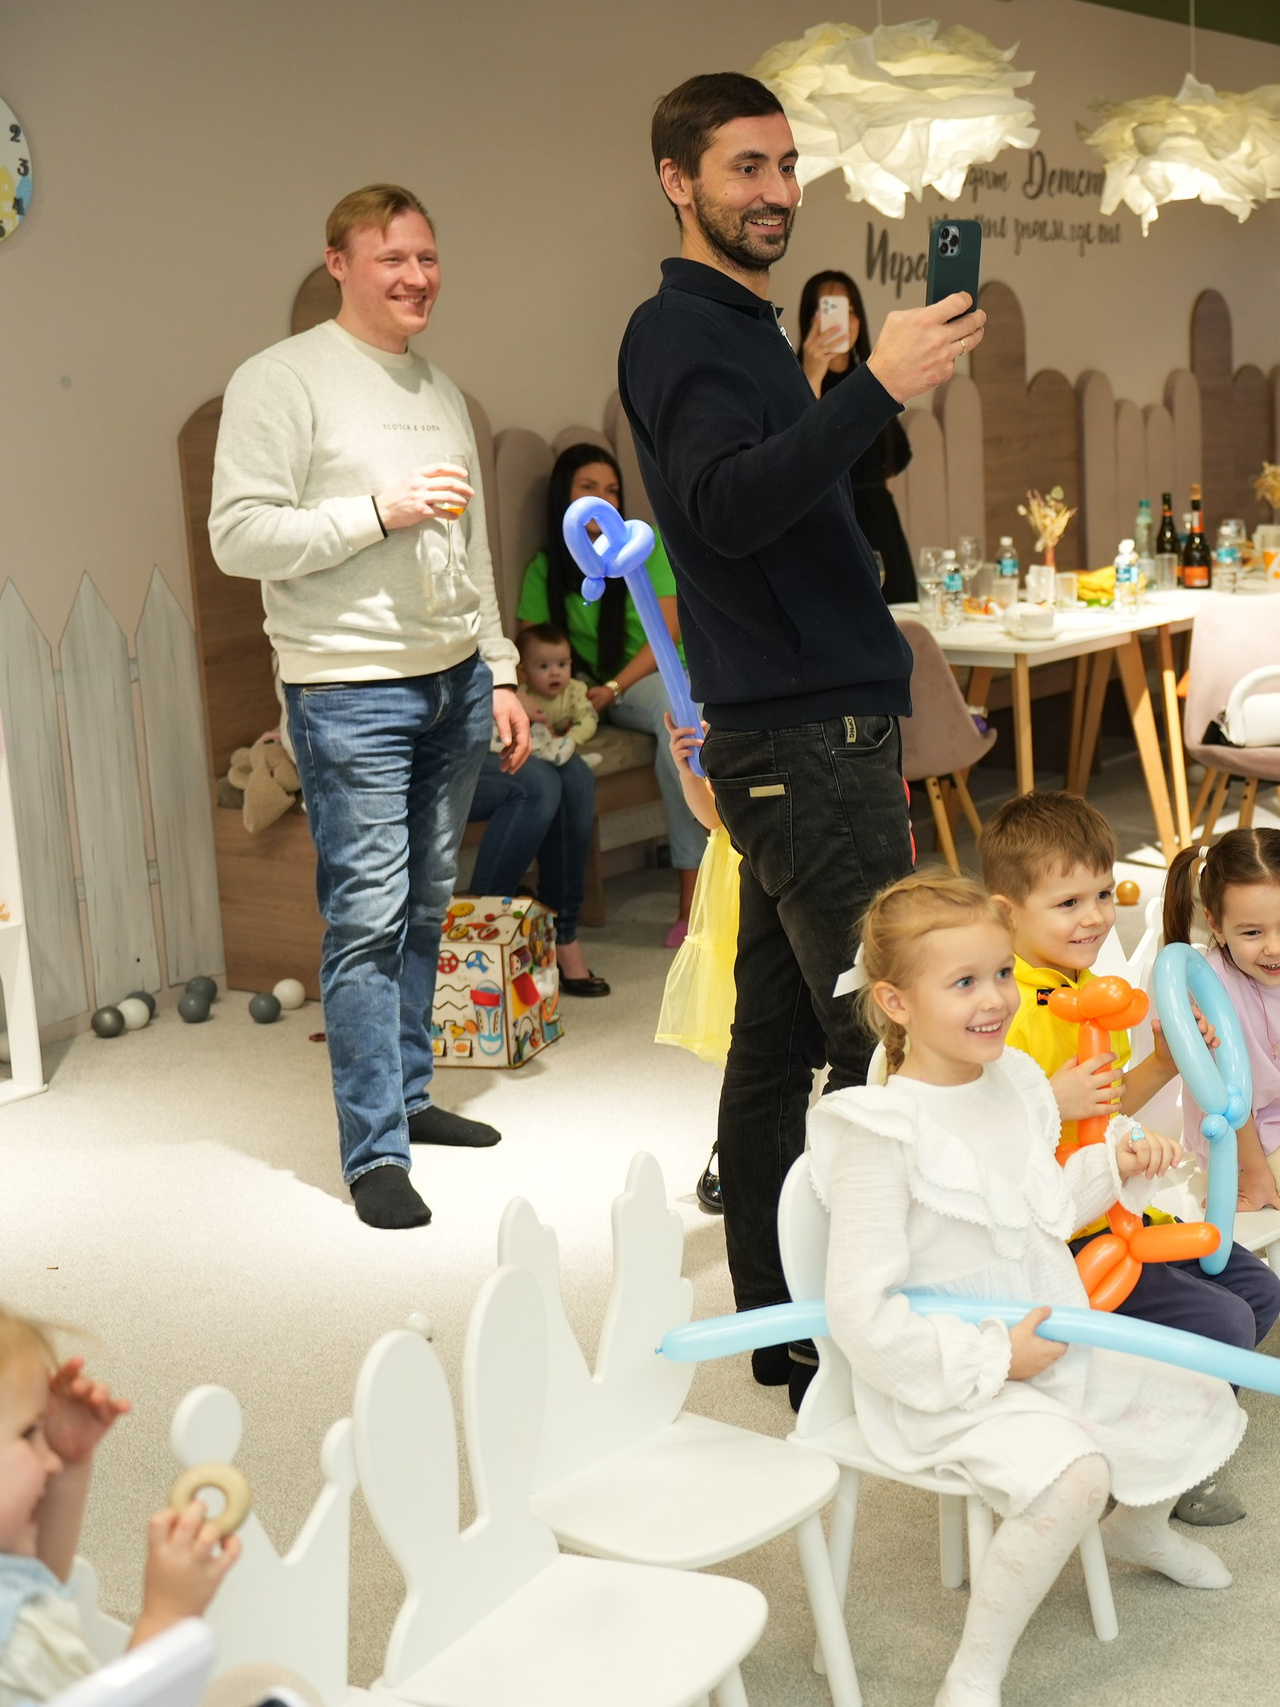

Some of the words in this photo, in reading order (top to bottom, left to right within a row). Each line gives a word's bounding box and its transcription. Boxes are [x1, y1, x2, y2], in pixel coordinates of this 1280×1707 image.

[9, 124, 21, 143] 2
[17, 158, 30, 177] 3
[1022, 150, 1106, 201] Детст
[12, 197, 25, 216] 4
[866, 221, 928, 299] Игра
